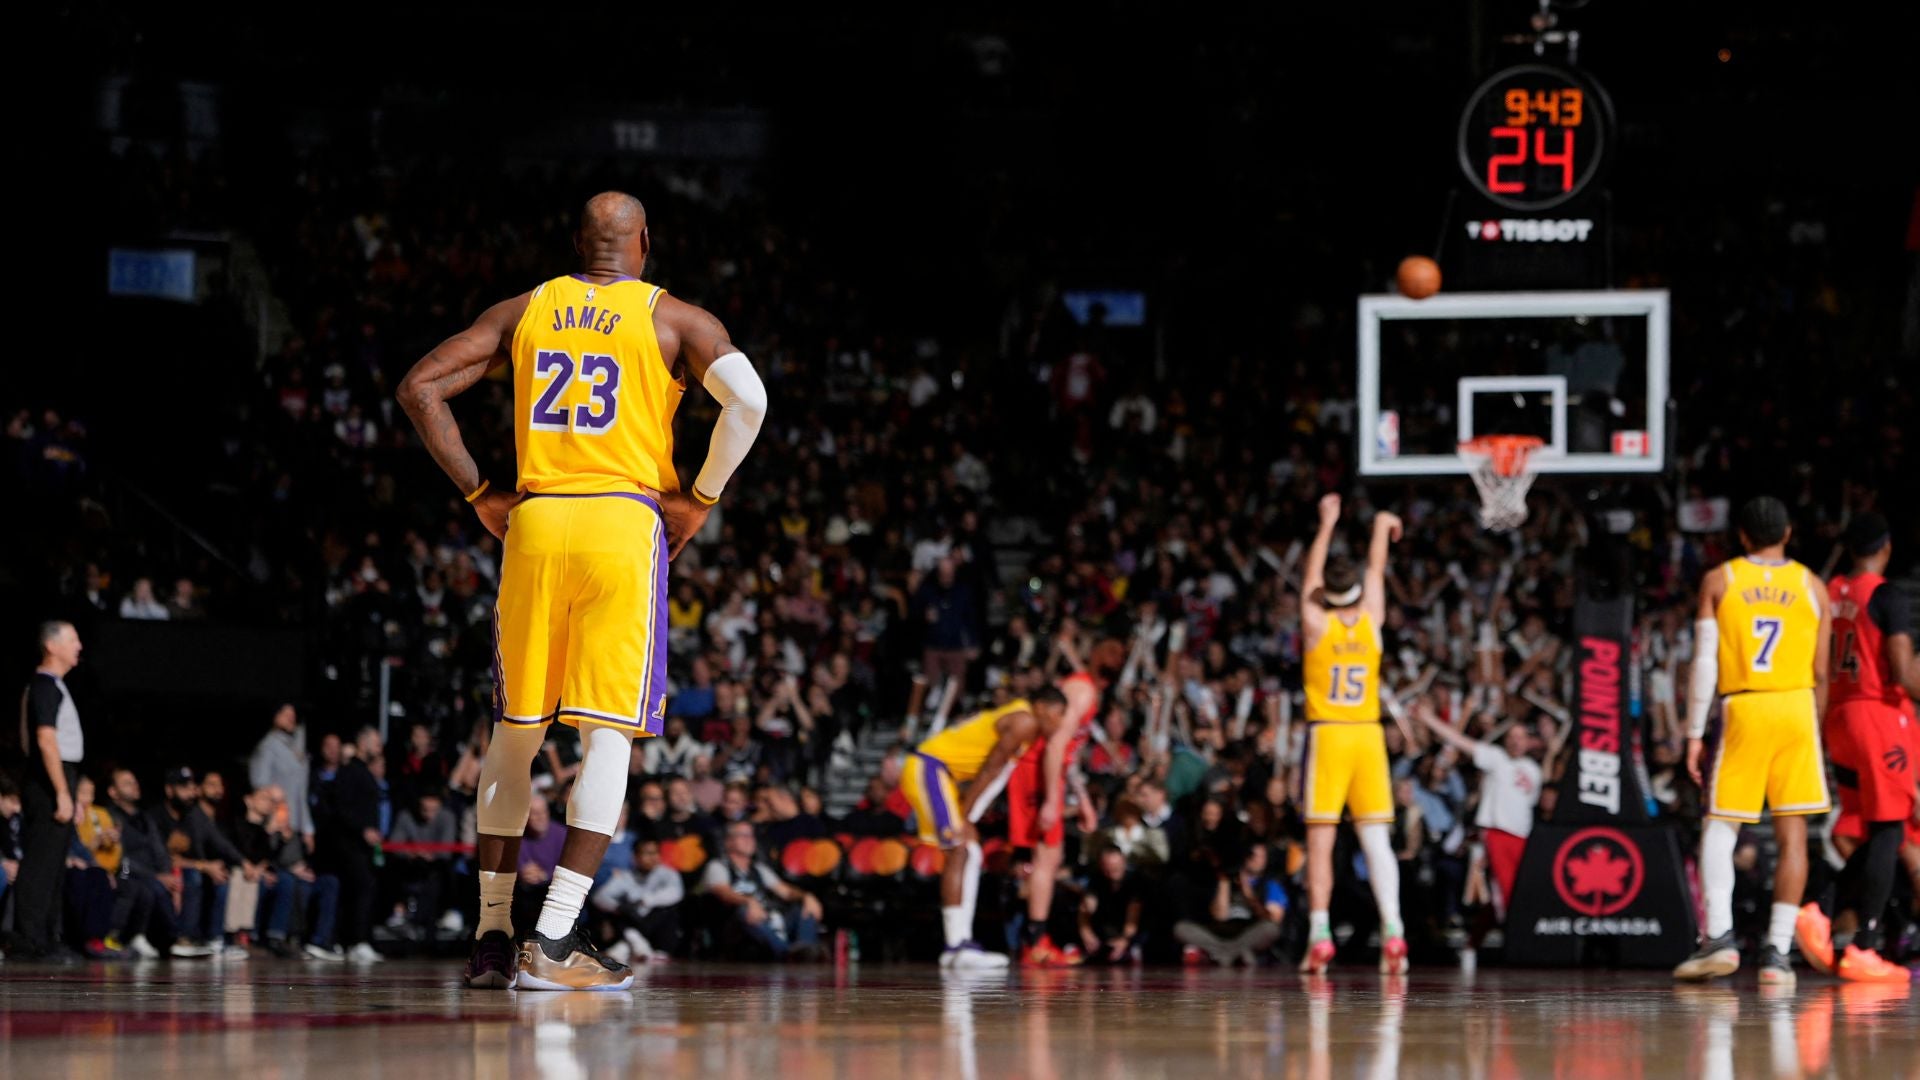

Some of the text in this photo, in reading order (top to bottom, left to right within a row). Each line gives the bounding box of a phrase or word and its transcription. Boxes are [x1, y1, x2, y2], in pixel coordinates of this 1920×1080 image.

[1504, 88, 1584, 126] 9:43
[1487, 127, 1575, 193] 24
[1500, 218, 1593, 242] TISSOT
[552, 305, 622, 336] JAMES
[529, 348, 621, 436] 23
[1751, 616, 1783, 672] 7
[1327, 664, 1368, 707] 15
[1534, 916, 1662, 936] AIR CANADA
